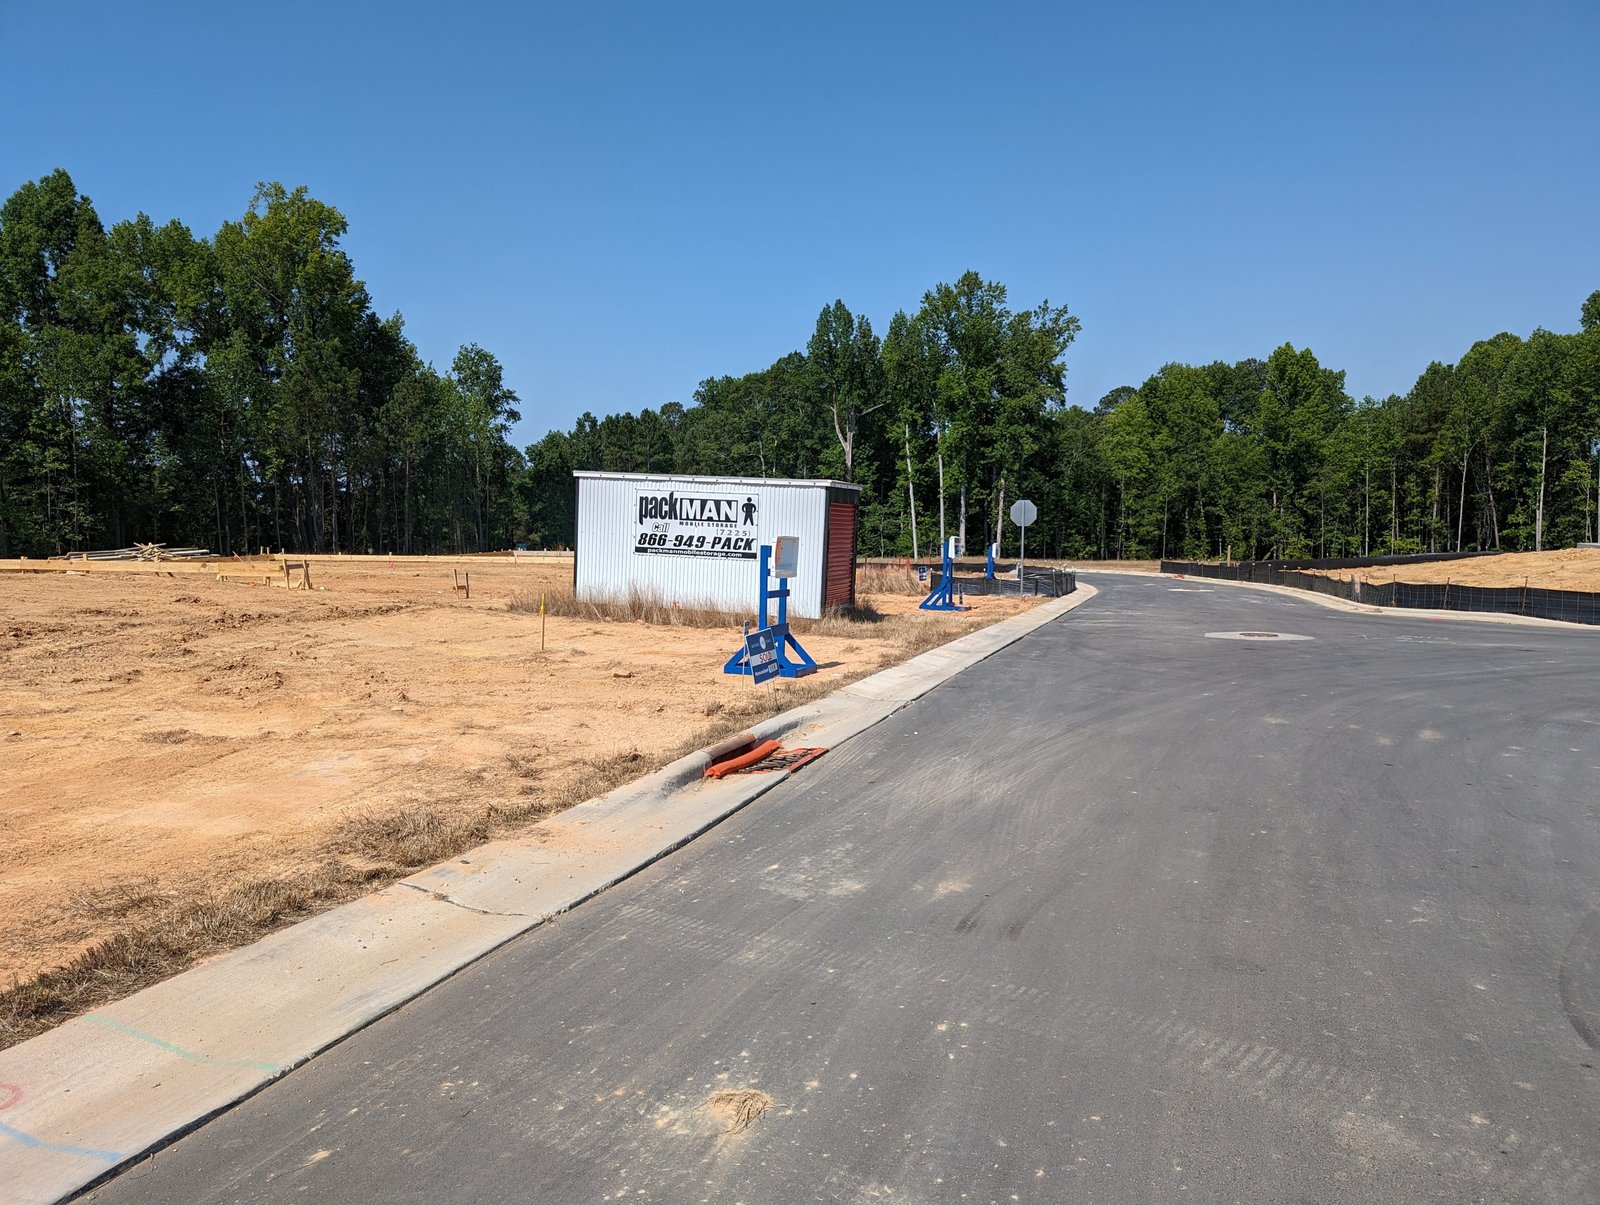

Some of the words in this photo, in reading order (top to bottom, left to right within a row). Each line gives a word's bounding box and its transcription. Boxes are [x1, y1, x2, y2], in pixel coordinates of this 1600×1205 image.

[651, 522, 670, 533] Call
[638, 532, 755, 551] 866-949-PACK
[647, 548, 743, 558] packmanmobilestorage.com
